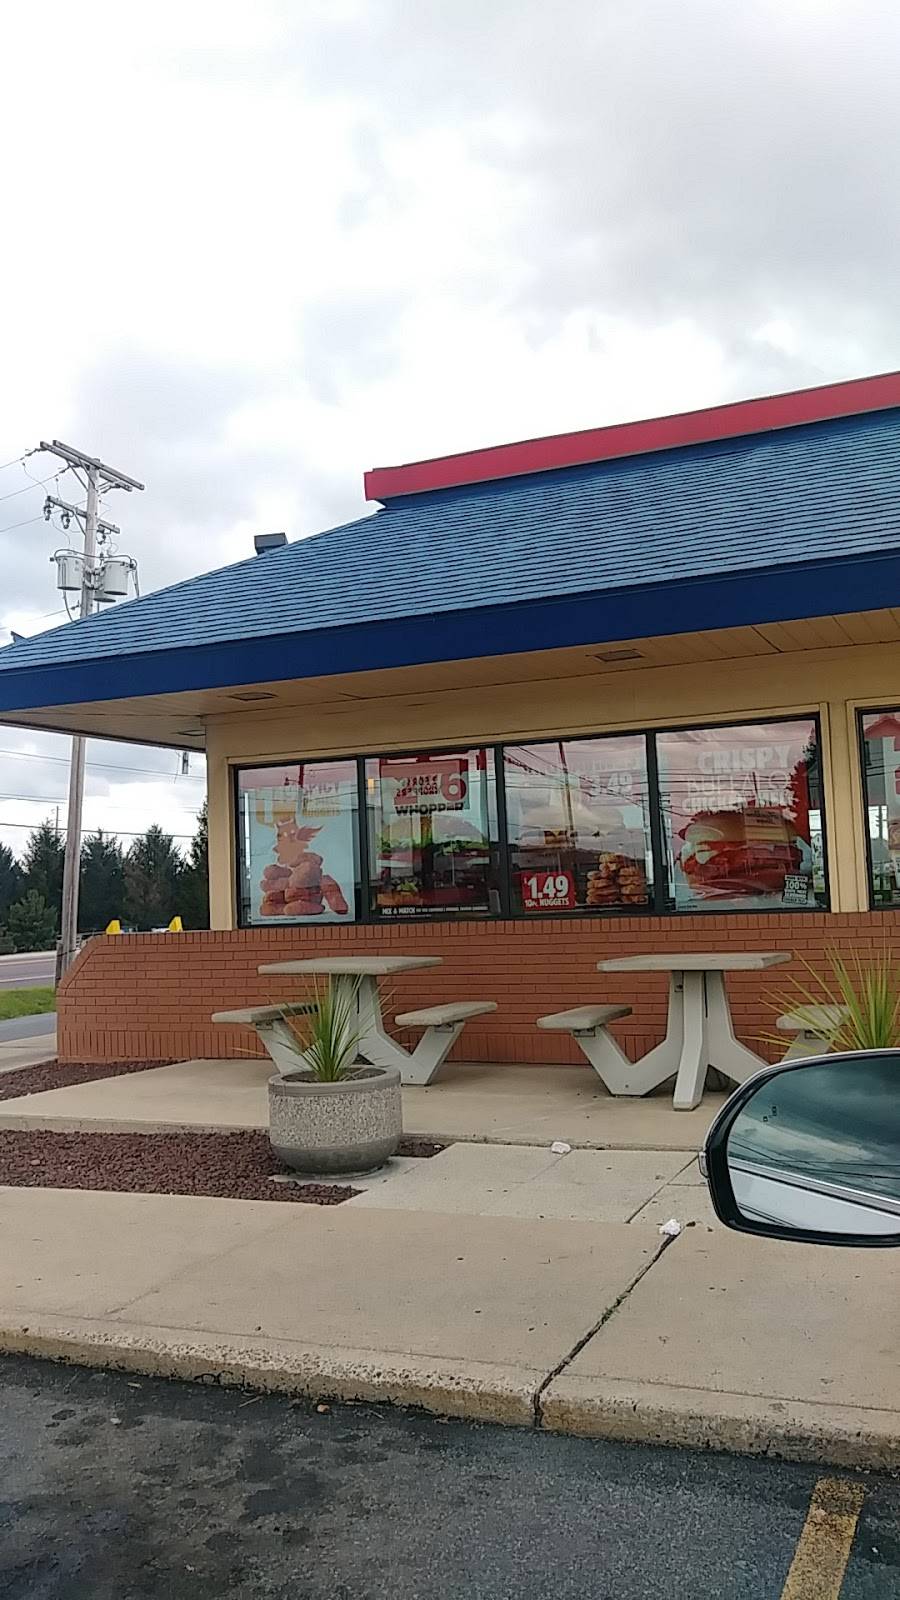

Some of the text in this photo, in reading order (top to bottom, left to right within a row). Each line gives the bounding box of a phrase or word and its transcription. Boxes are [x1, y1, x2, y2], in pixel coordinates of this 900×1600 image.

[697, 744, 791, 775] CRISPY
[395, 802, 464, 816] WHOPPER
[785, 880, 808, 890] 100%
[539, 897, 570, 906] NUGGETS
